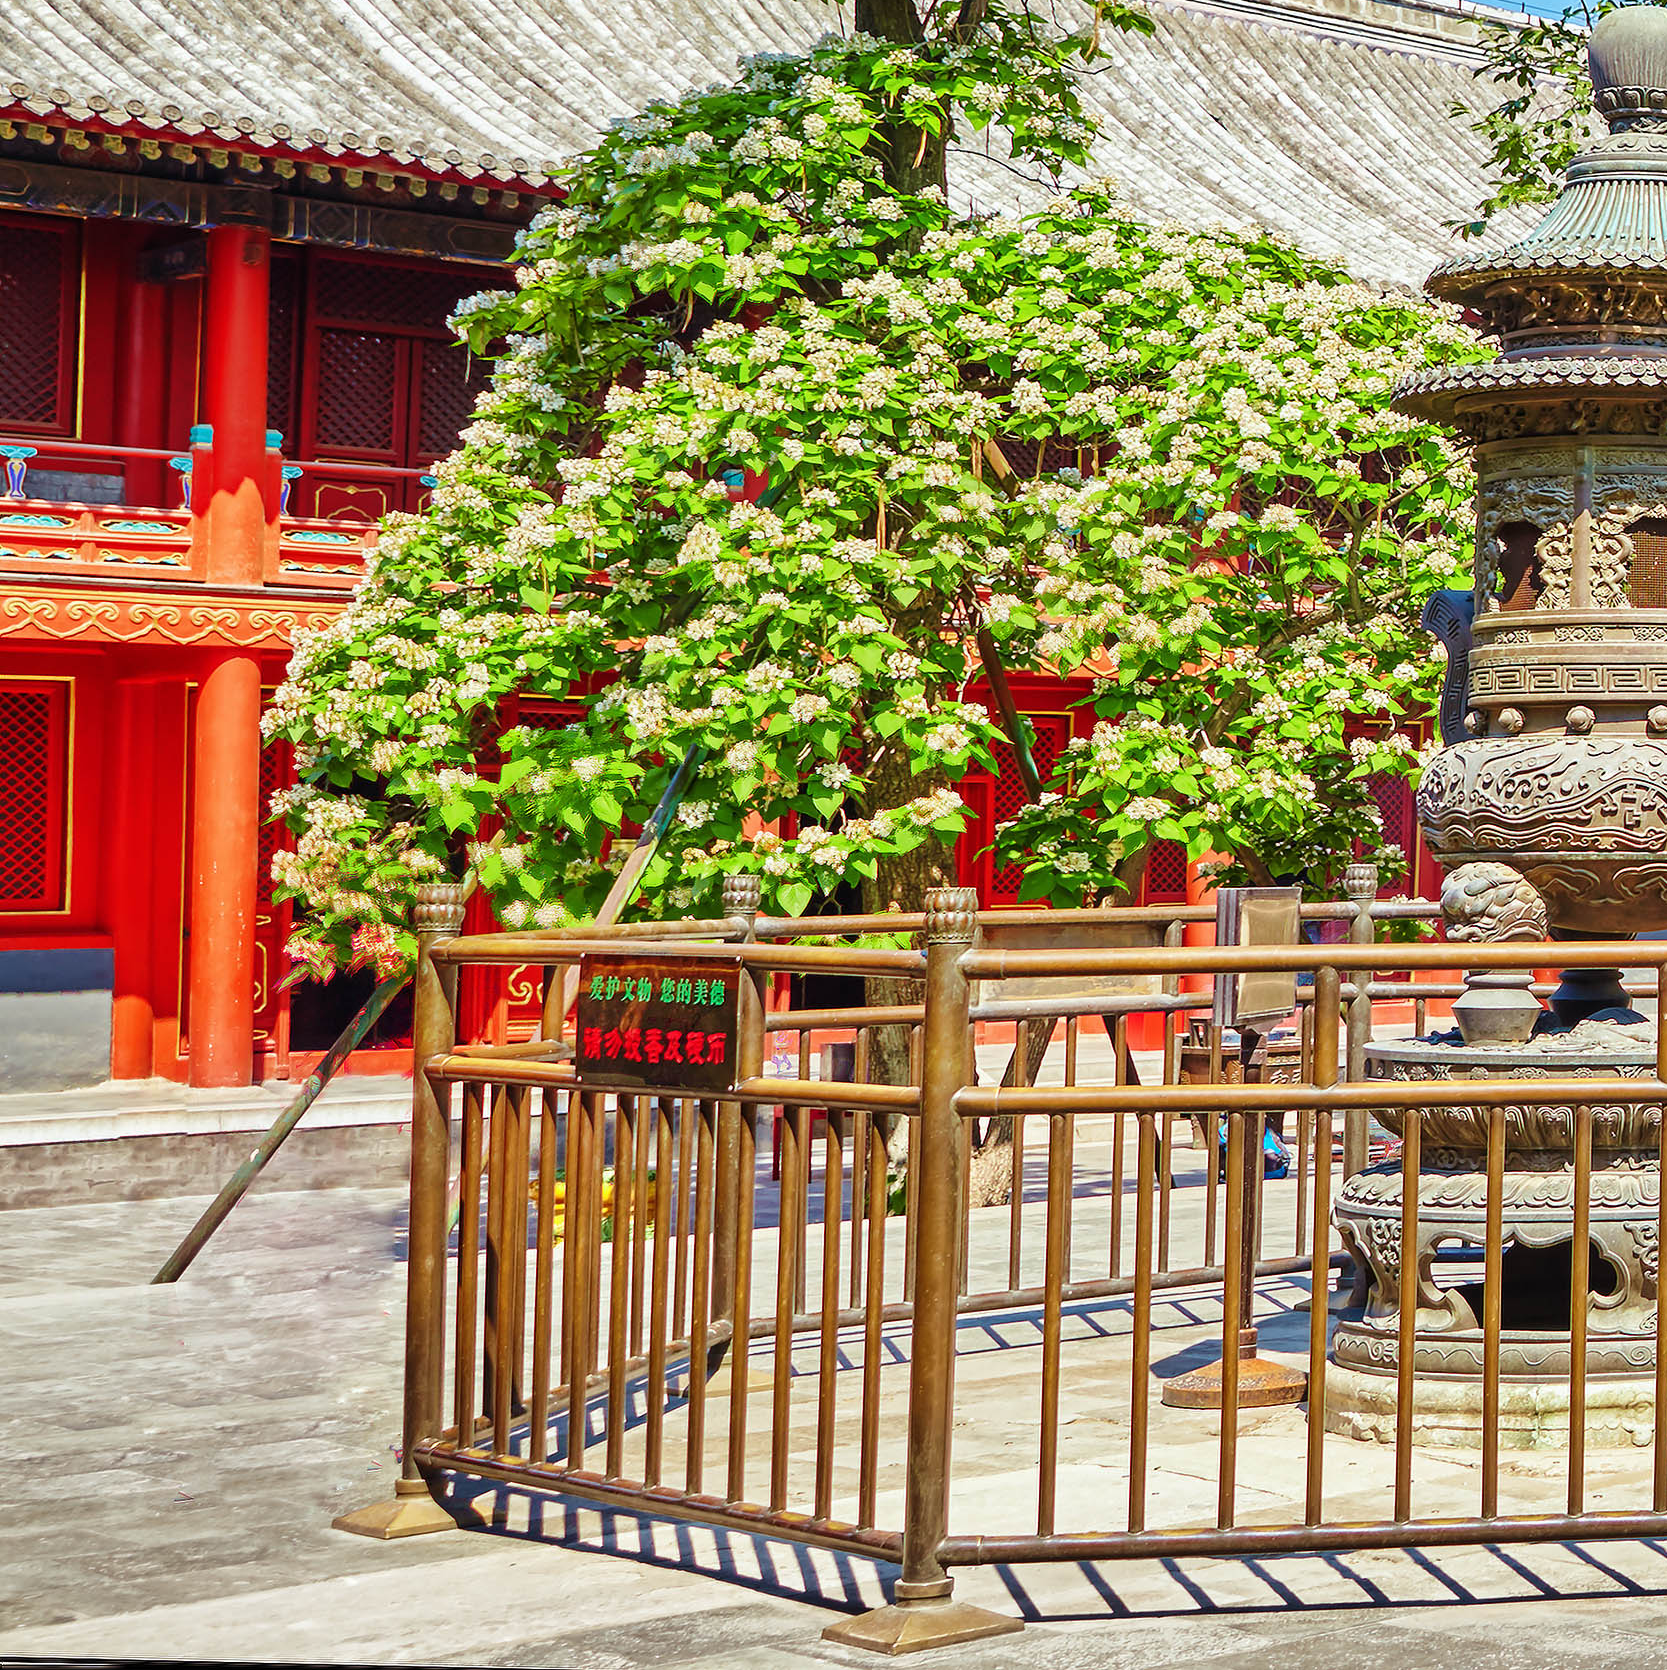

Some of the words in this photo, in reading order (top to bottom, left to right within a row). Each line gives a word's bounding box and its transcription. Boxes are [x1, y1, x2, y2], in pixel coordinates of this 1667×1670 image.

[589, 975, 652, 1002] 爱护文物
[660, 977, 726, 1006] 您的美德
